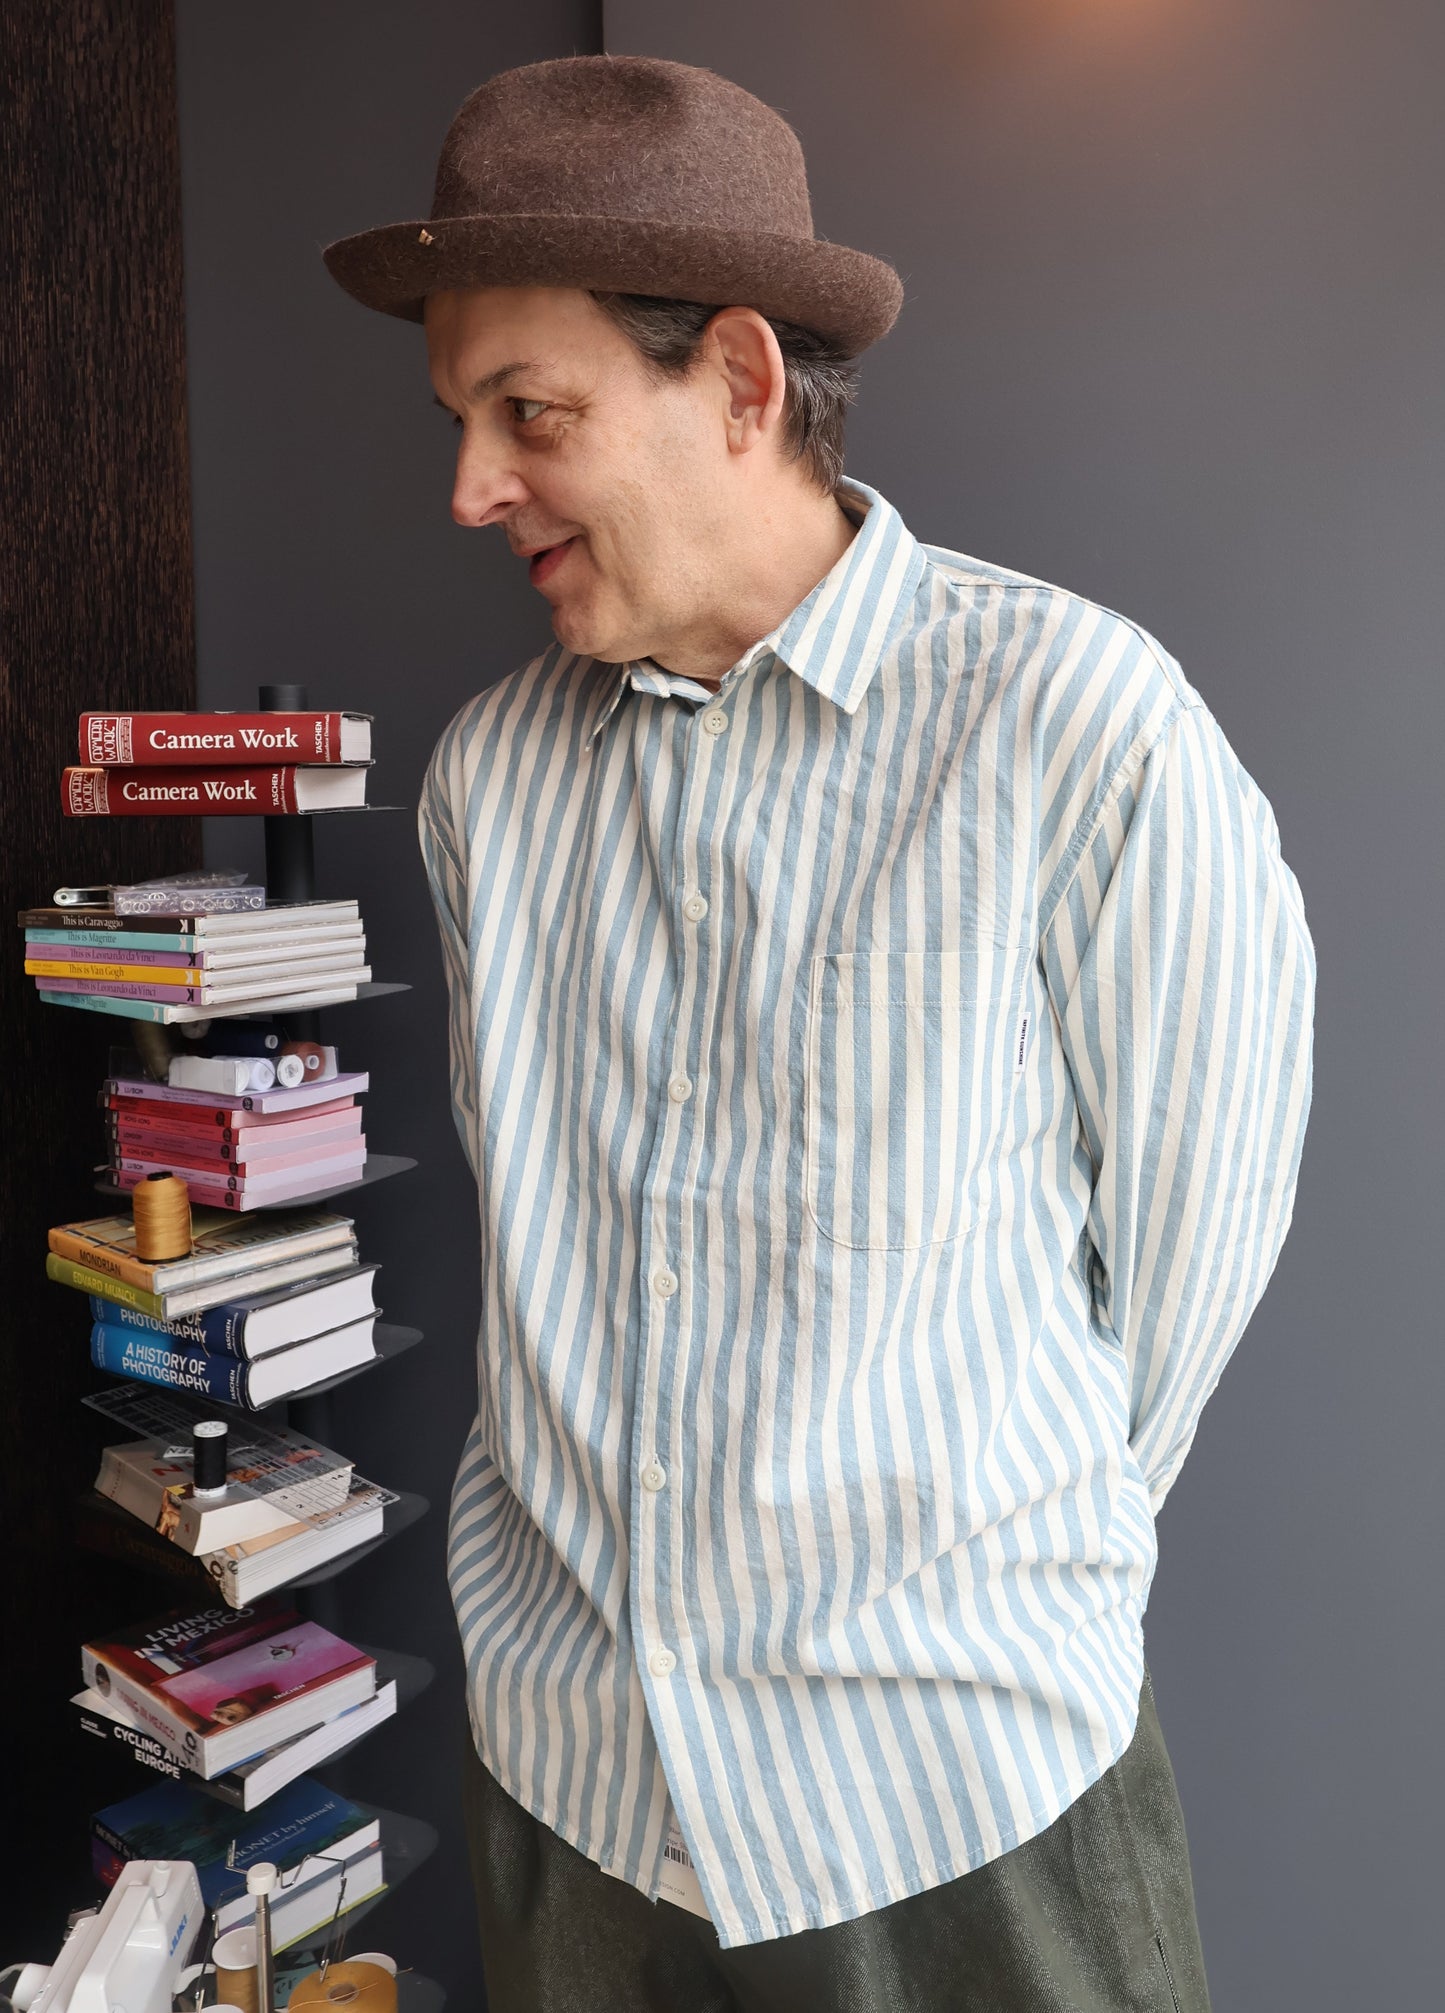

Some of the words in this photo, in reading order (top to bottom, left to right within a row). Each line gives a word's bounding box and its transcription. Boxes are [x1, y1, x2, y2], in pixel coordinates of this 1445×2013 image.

[149, 730, 235, 749] Camera
[239, 727, 299, 749] Work
[315, 721, 323, 754] TASCHEN
[122, 782, 199, 800] Camera
[202, 780, 257, 800] Work
[271, 773, 280, 806] TASCHEN
[61, 915, 76, 926] This
[77, 916, 83, 926] is
[84, 916, 123, 930] Caravaggio
[67, 931, 80, 941] This
[88, 933, 117, 945] Magritte
[68, 964, 82, 974] This
[91, 965, 104, 975] Van
[105, 966, 124, 979] Gogh
[70, 949, 84, 959] This
[92, 950, 125, 961] Leonardo
[126, 952, 135, 962] da
[135, 951, 156, 963] Vinci
[96, 983, 128, 995] Leonardo
[129, 986, 137, 996] da
[137, 986, 156, 997] Vinci
[79, 1249, 121, 1277] MONDRIAN
[72, 1271, 103, 1292] EDVARD
[104, 1283, 136, 1305] MUNCH
[120, 1308, 207, 1344] PHOTOGRAPHY
[224, 1319, 232, 1350] TASCHEN
[126, 1342, 134, 1356] A
[135, 1344, 188, 1371] HISTORY
[189, 1359, 207, 1375] OF
[122, 1356, 211, 1394] PHOTOGRAPHY
[227, 1369, 236, 1400] TASCHEN
[133, 1643, 164, 1659] IN
[166, 1608, 255, 1648] MEXICO
[145, 1608, 224, 1643] LIVING
[273, 1684, 306, 1700] TASCHEN
[113, 1726, 161, 1757] CYCLING
[135, 1749, 181, 1779] EUROPE
[280, 1820, 298, 1836] by
[298, 1801, 336, 1825] himself
[169, 1914, 189, 1957] JUKI
